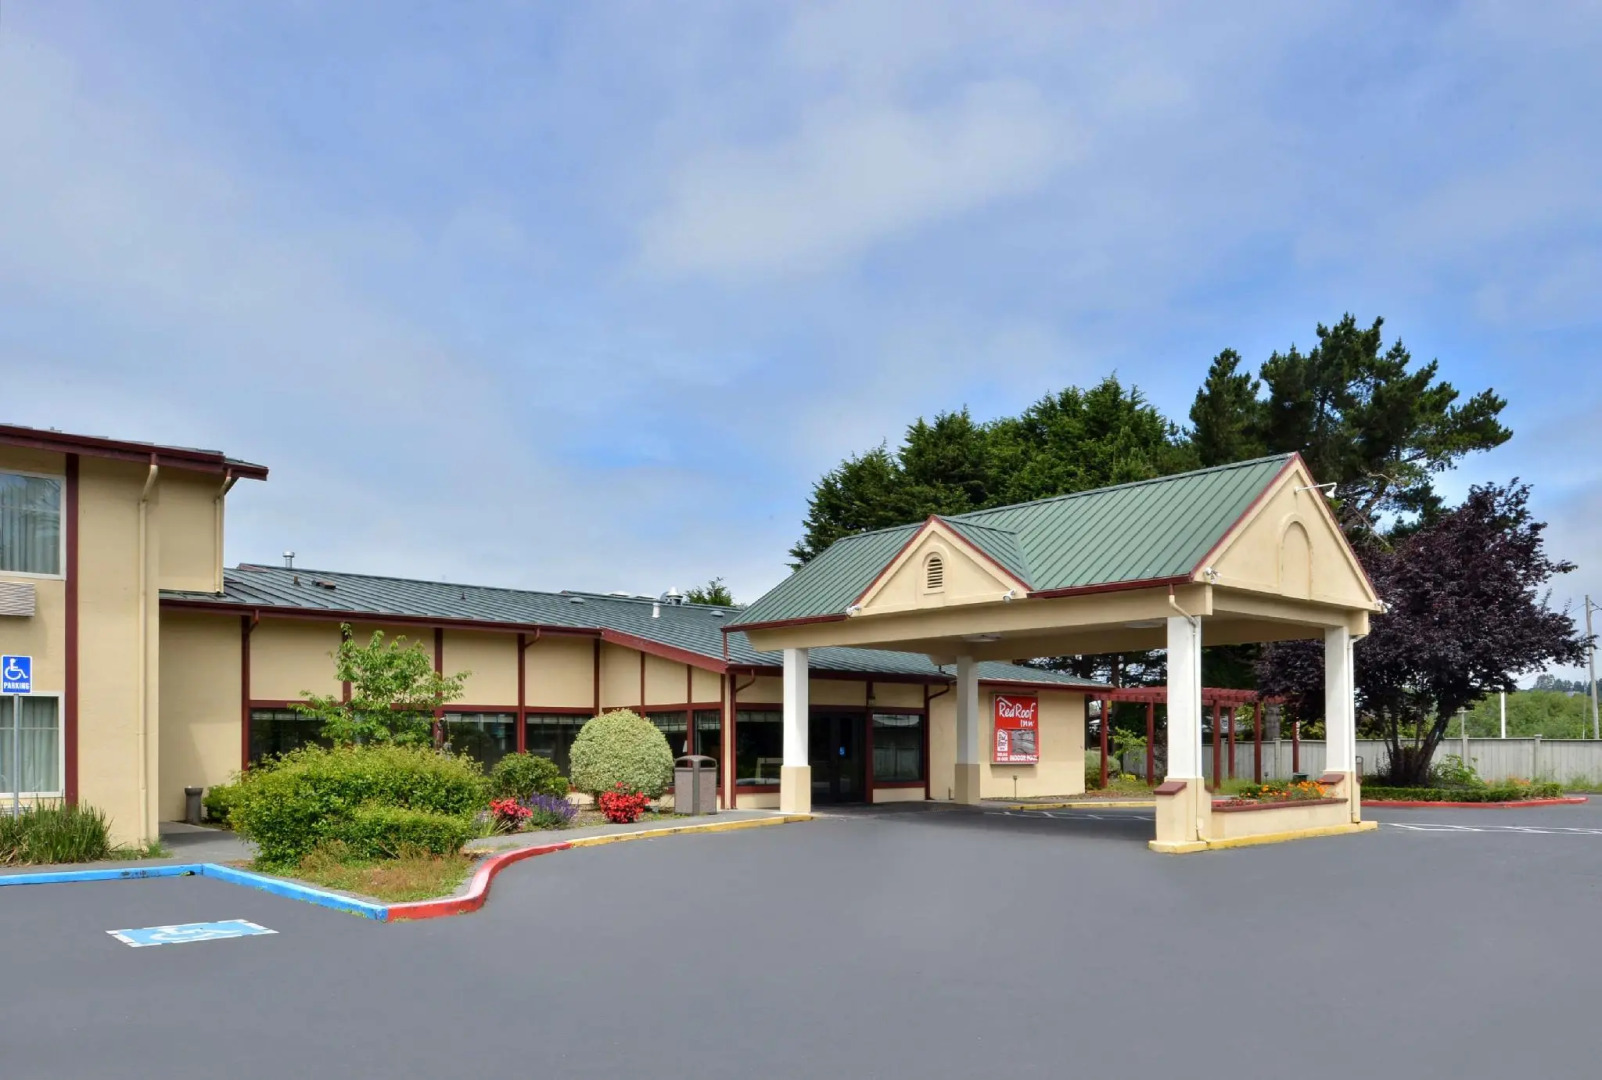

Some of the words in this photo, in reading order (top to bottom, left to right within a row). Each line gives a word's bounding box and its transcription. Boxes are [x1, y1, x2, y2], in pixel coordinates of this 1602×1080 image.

[4, 682, 30, 690] PARKING
[999, 702, 1015, 717] Red
[1015, 703, 1036, 719] Roof
